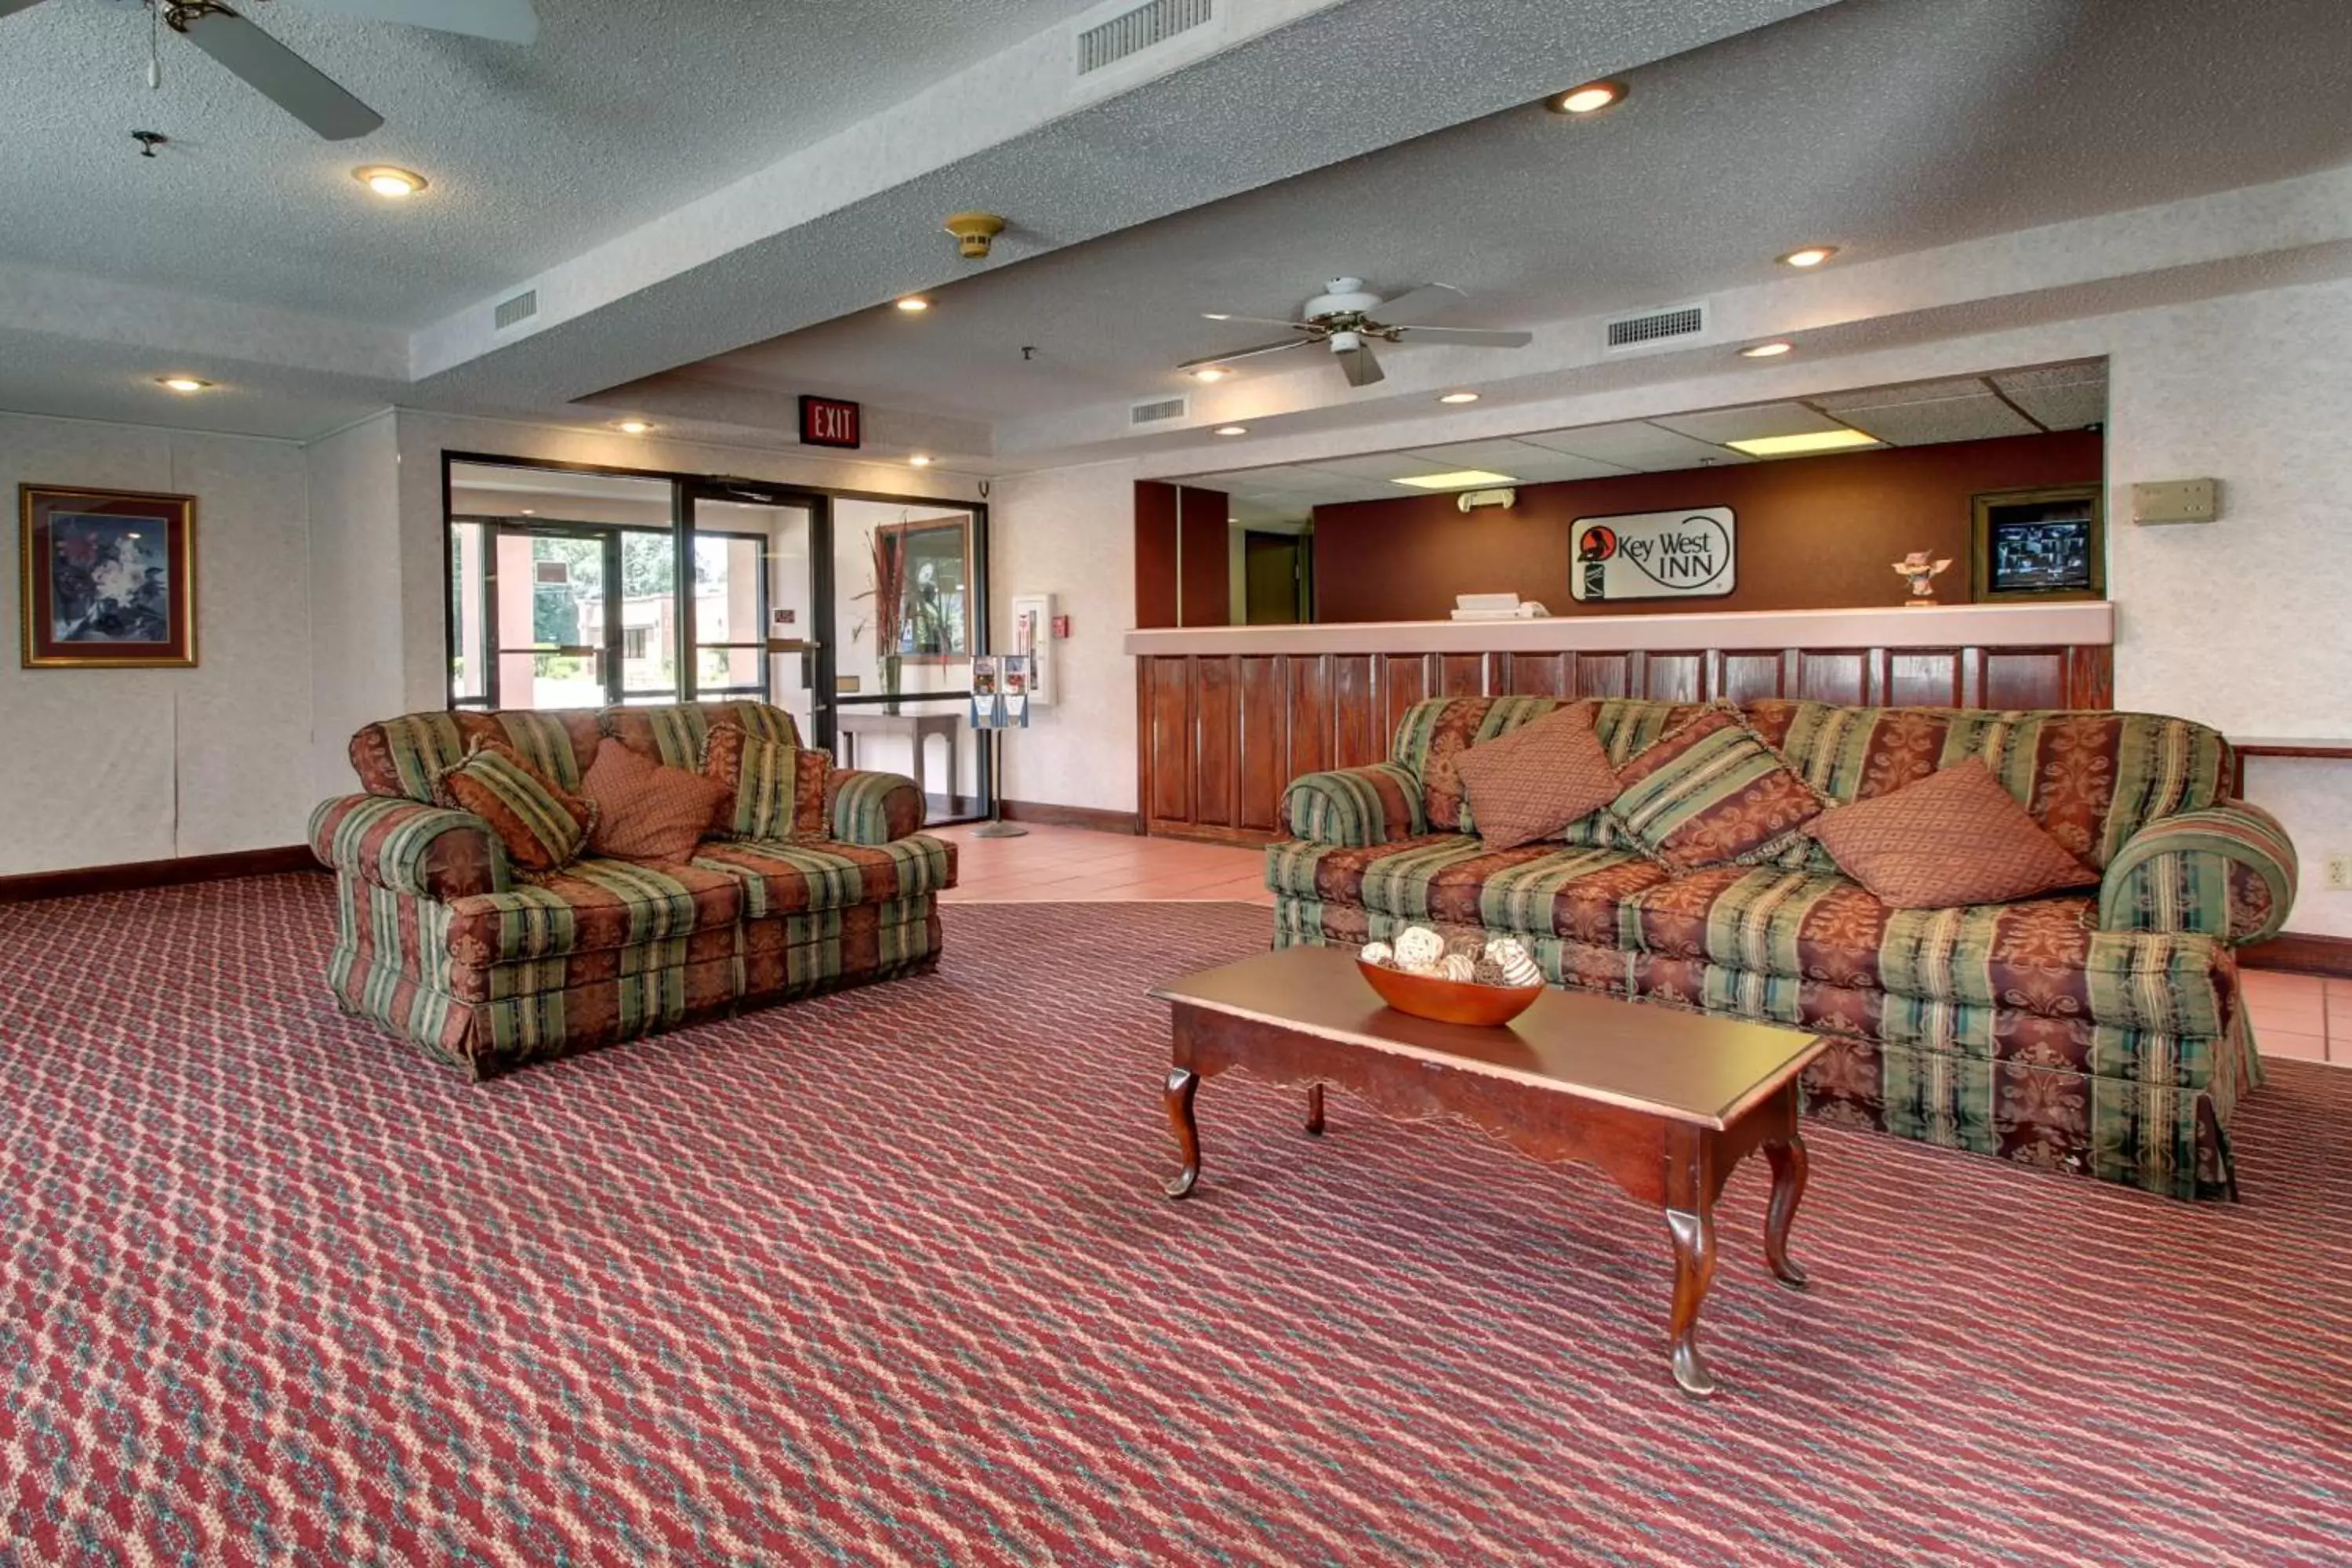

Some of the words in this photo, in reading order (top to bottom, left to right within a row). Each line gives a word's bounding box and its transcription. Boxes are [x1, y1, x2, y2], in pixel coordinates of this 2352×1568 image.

[815, 405, 851, 440] EXIT
[1618, 536, 1654, 562] Key
[1659, 532, 1712, 554] West
[1660, 554, 1712, 579] INN
